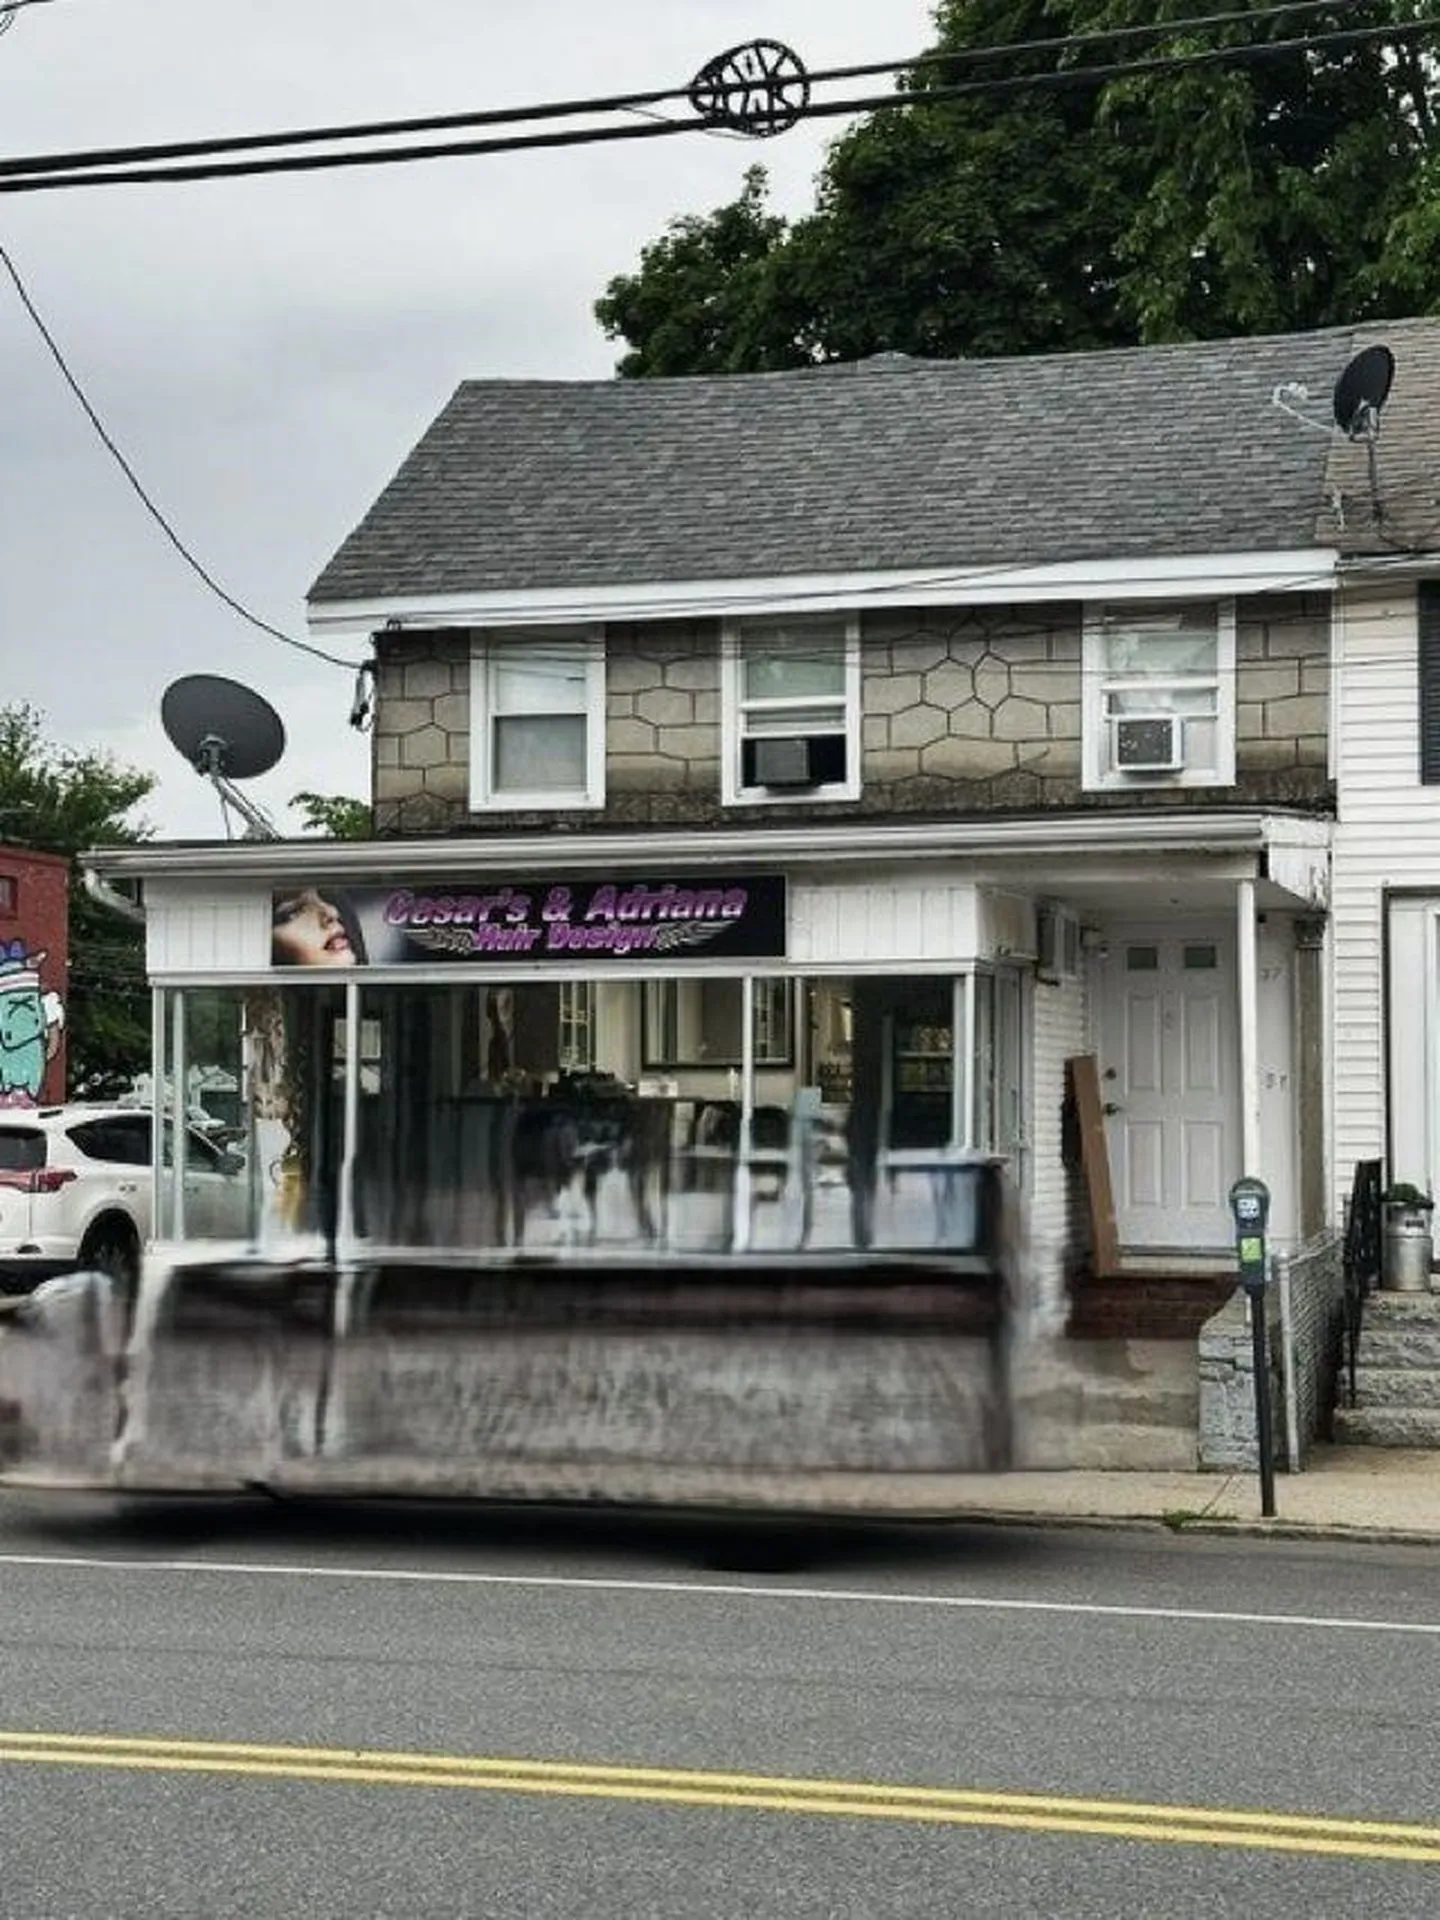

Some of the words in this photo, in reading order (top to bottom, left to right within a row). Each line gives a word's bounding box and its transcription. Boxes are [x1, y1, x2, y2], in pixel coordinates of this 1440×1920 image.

[384, 888, 532, 924] Cesar's
[542, 886, 573, 921] &
[585, 884, 748, 921] Adriana
[474, 922, 542, 951] Hair
[547, 920, 656, 955] Design
